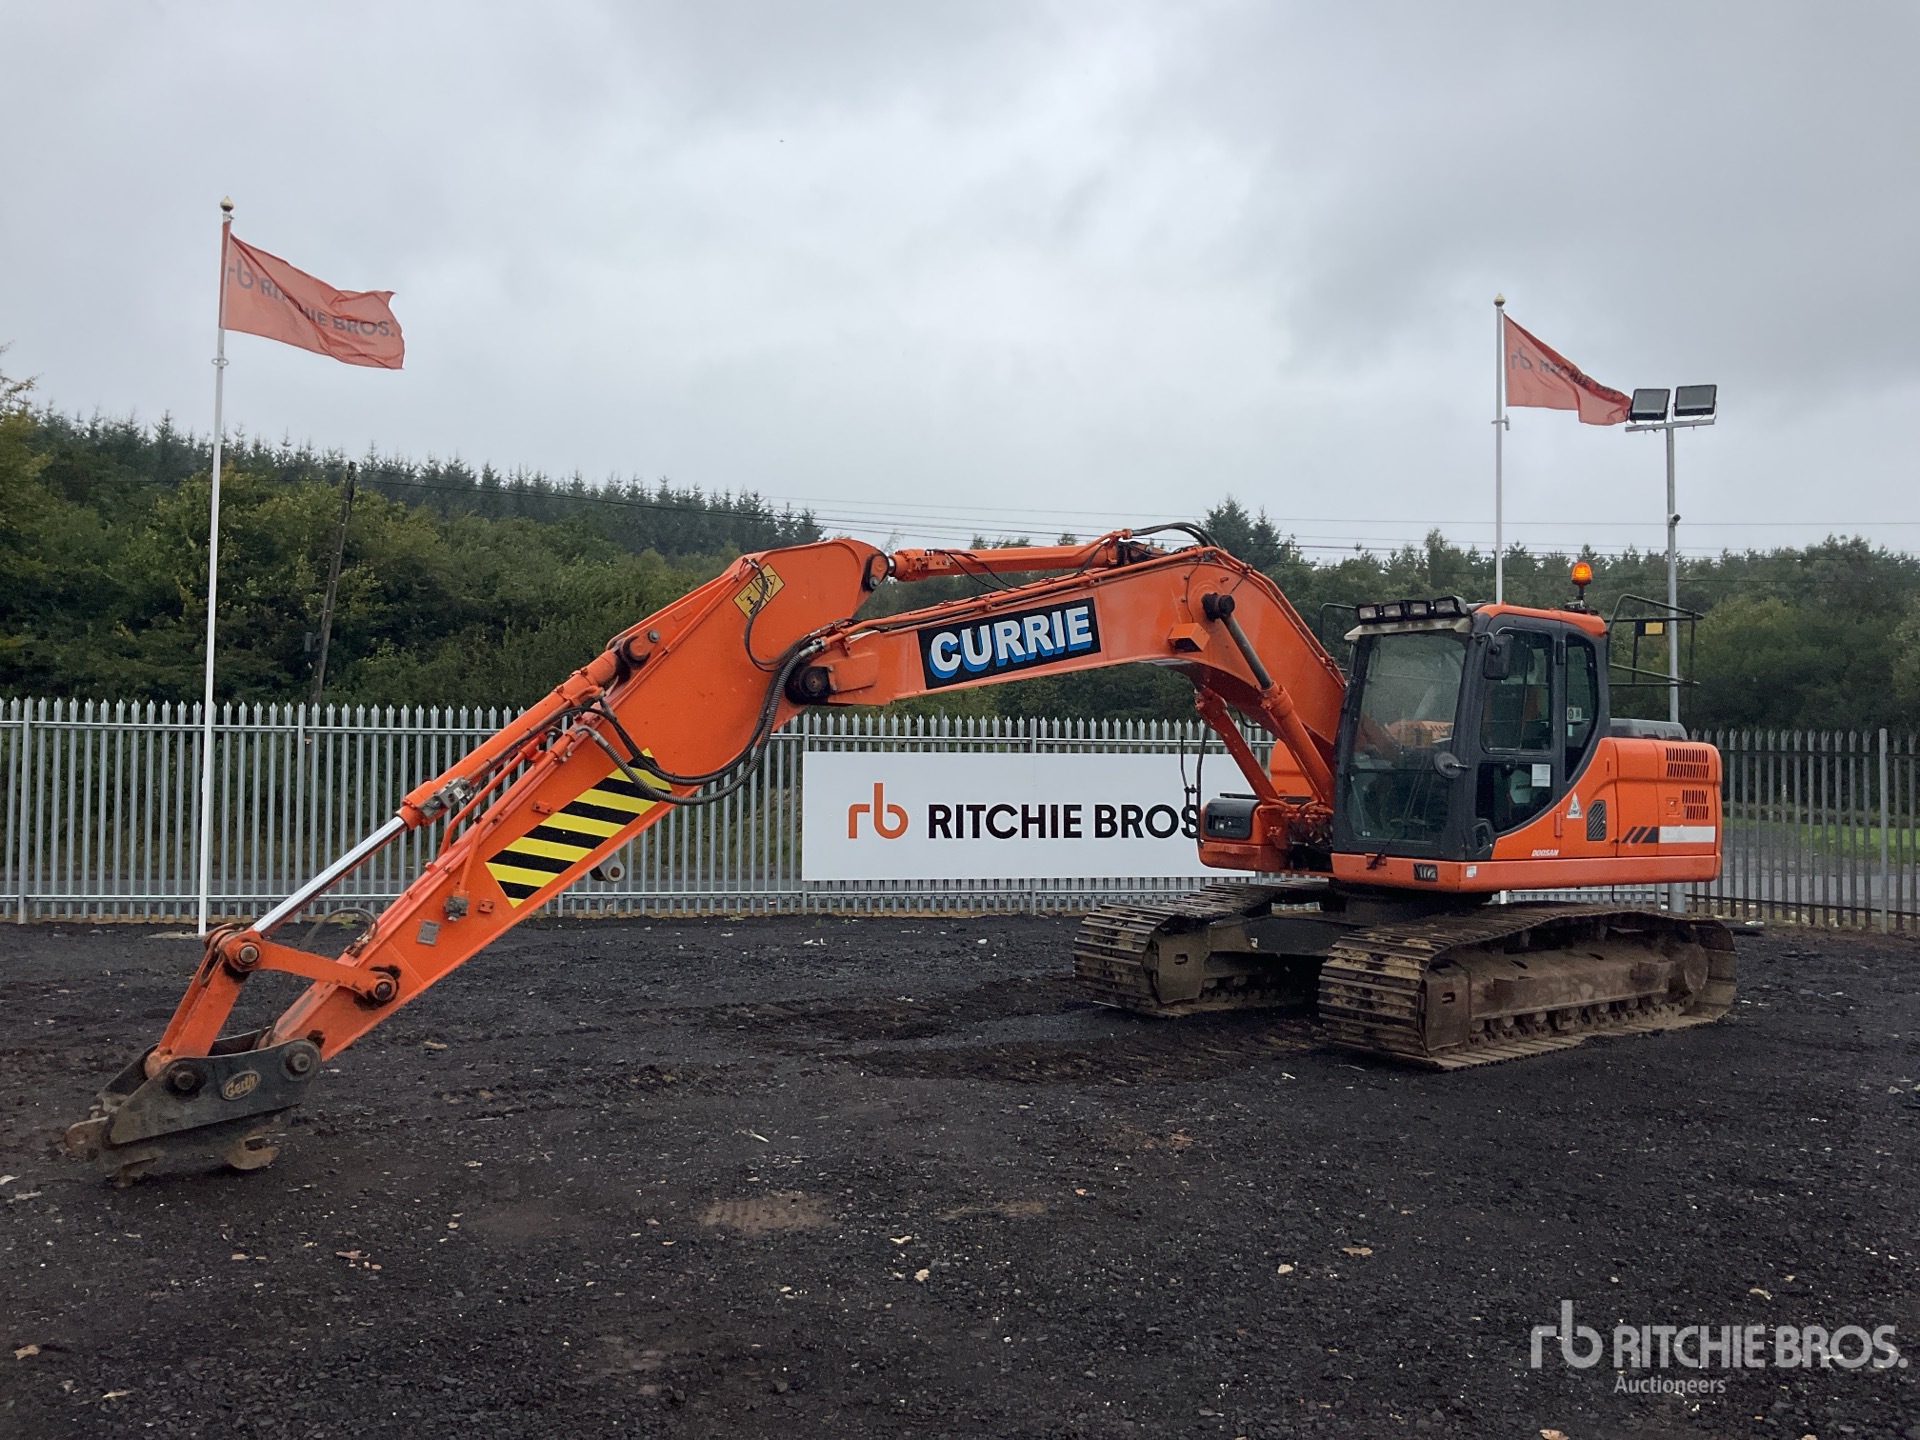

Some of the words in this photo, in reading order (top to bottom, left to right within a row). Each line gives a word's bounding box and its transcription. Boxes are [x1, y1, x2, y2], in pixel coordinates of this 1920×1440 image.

[333, 315, 396, 337] BROS.
[929, 606, 1092, 679] CURRIE
[848, 783, 908, 839] rb
[928, 804, 1082, 839] RITCHIE
[1531, 849, 1559, 857] DOOSAN
